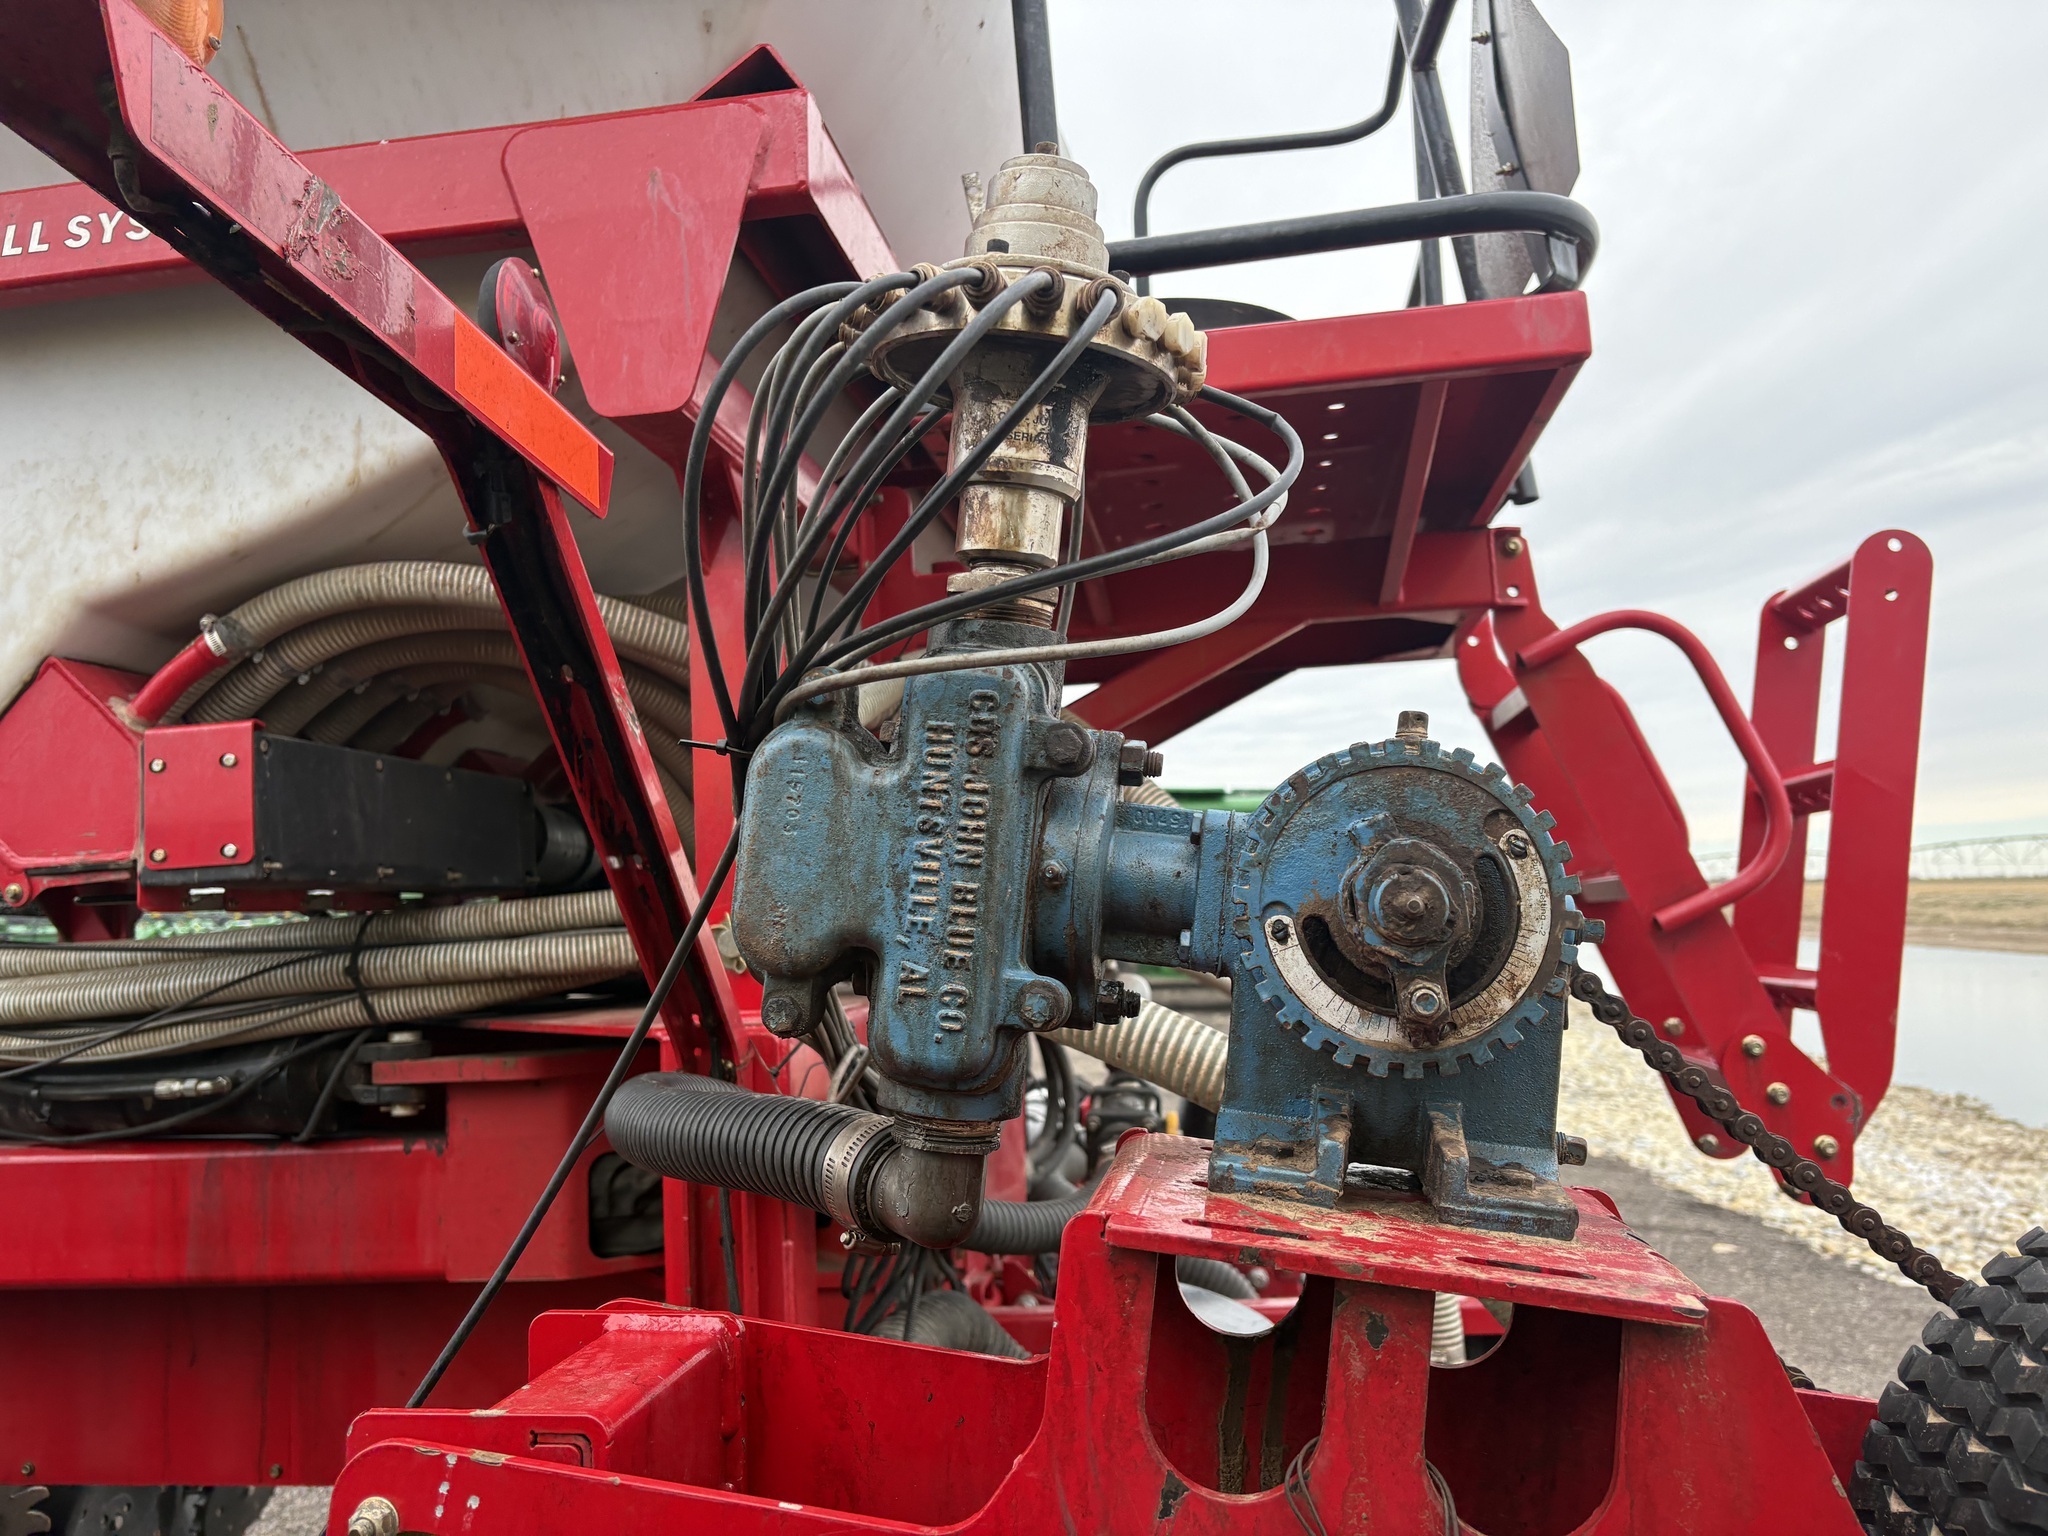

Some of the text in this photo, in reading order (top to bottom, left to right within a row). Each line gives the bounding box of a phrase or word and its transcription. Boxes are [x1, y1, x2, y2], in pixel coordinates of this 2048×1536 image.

[943, 881, 981, 972] BLUE
[898, 960, 930, 1004] AL
[934, 984, 970, 1043] CO.
